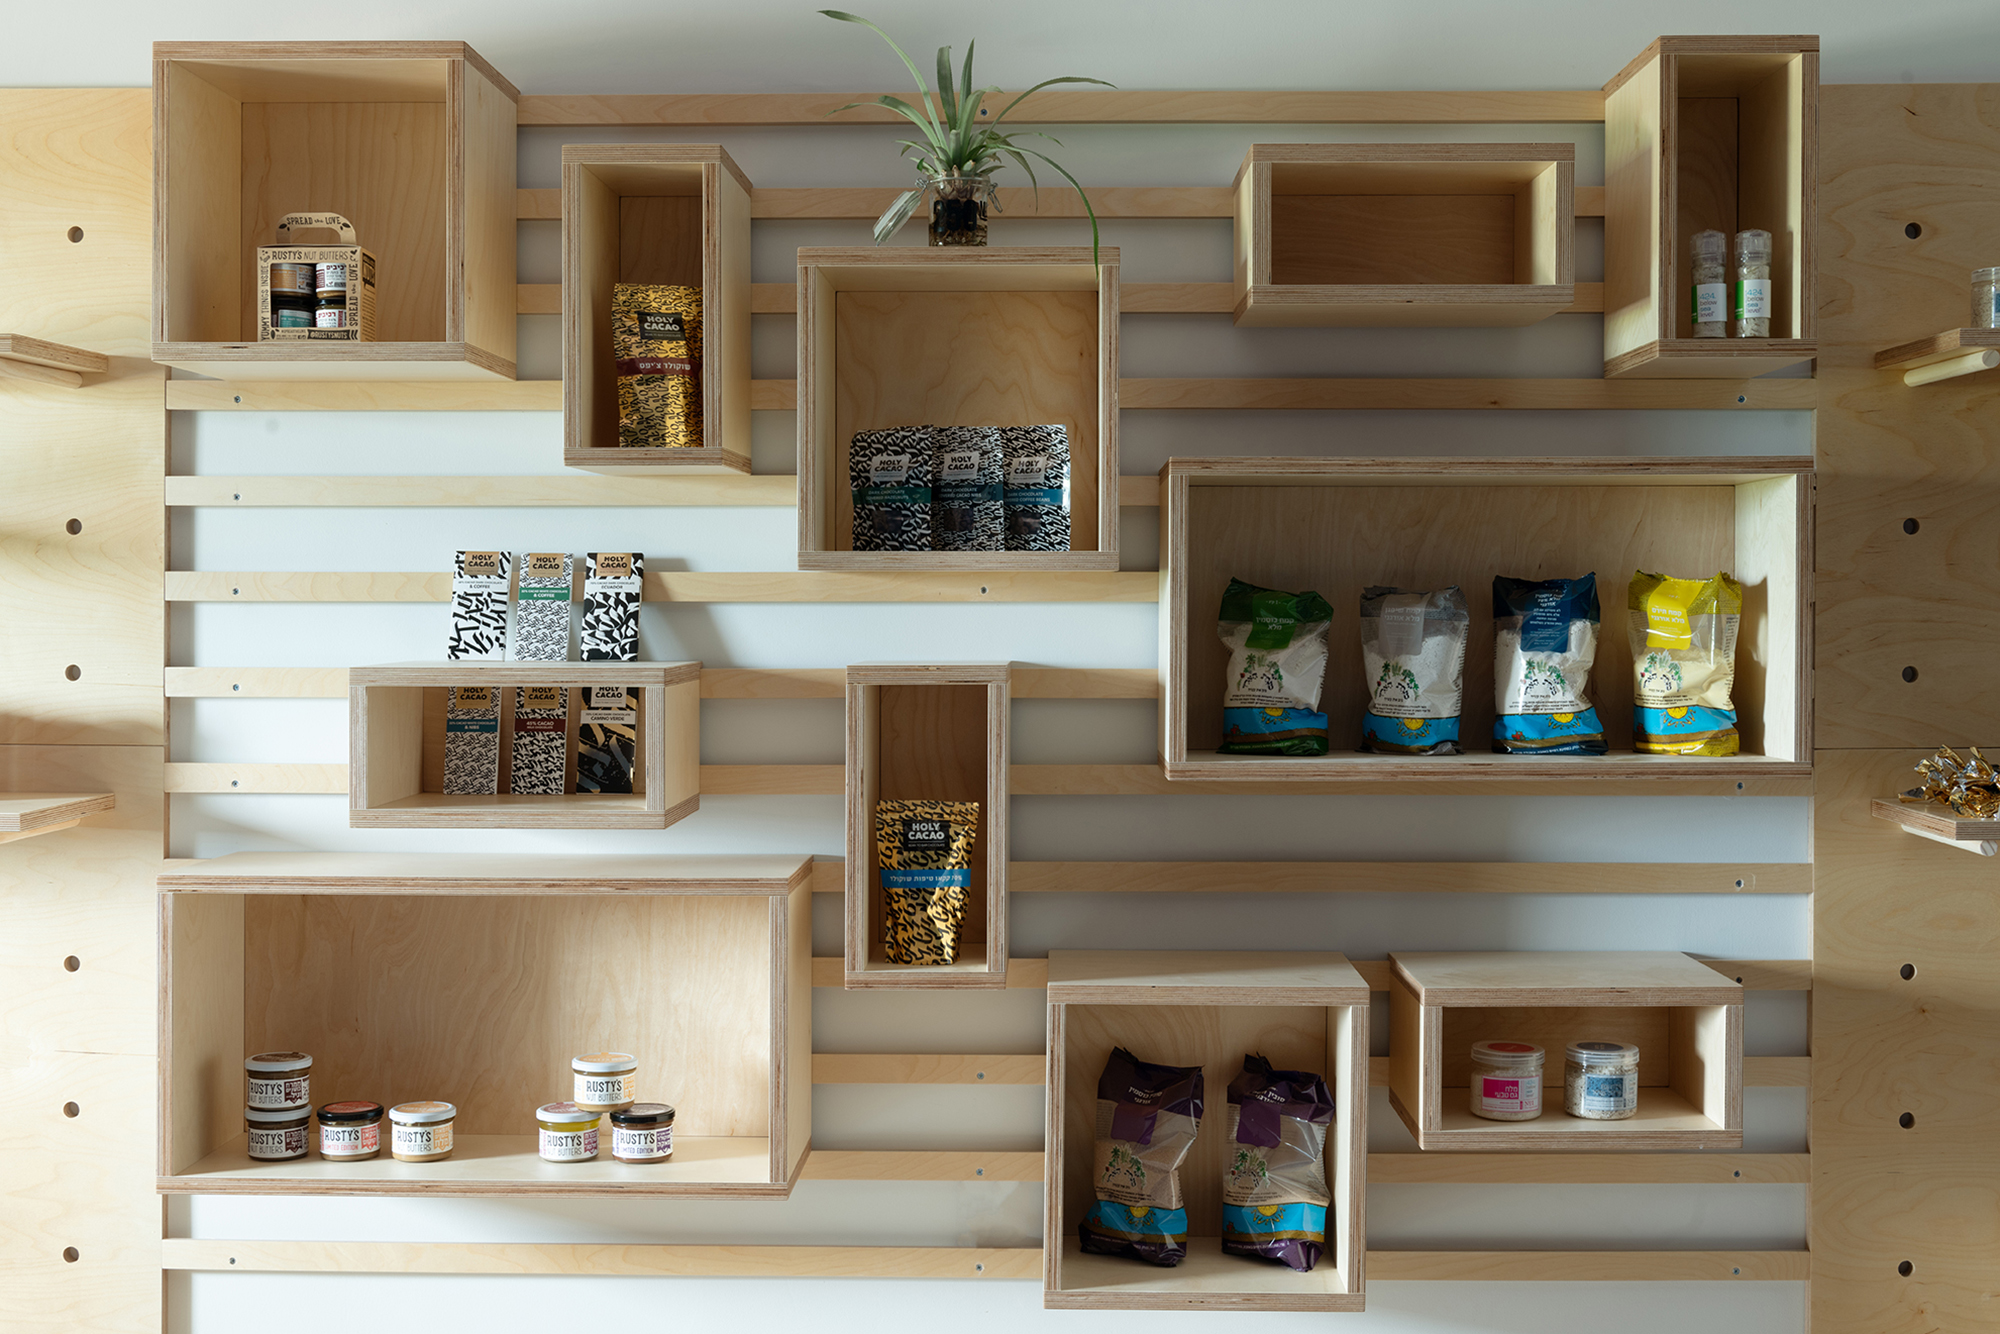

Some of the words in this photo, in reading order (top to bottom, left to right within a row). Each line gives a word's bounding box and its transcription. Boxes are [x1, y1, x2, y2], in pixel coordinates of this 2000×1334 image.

[286, 217, 313, 225] SPREAD
[325, 216, 341, 225] LOVE
[272, 250, 302, 260] RUSTY'S
[304, 251, 316, 260] NUT
[319, 251, 348, 260] BUTTERS
[261, 264, 269, 286] INSIDE
[349, 264, 358, 281] LOVE
[261, 288, 269, 314] THINGS
[349, 296, 358, 326] SPREAD
[261, 317, 269, 341] YUMMY
[644, 322, 680, 331] CACAO
[912, 823, 940, 831] HOLY
[908, 831, 945, 840] CACAO
[250, 1082, 282, 1095] RUSTY'S
[586, 1079, 622, 1093] RUSTY'S
[258, 1096, 282, 1104] BUTTERS
[598, 1093, 622, 1102] BUTTERS
[250, 1132, 283, 1145] RUSTY'S
[325, 1128, 359, 1141] RUSTY'S
[397, 1130, 431, 1143] RUSTY'S
[547, 1134, 582, 1147] RUSTY'S
[620, 1132, 655, 1144] RUSTY'S
[259, 1146, 283, 1154] BUTTERS
[408, 1143, 432, 1152] BUTTERS
[558, 1147, 582, 1156] BUTTERS
